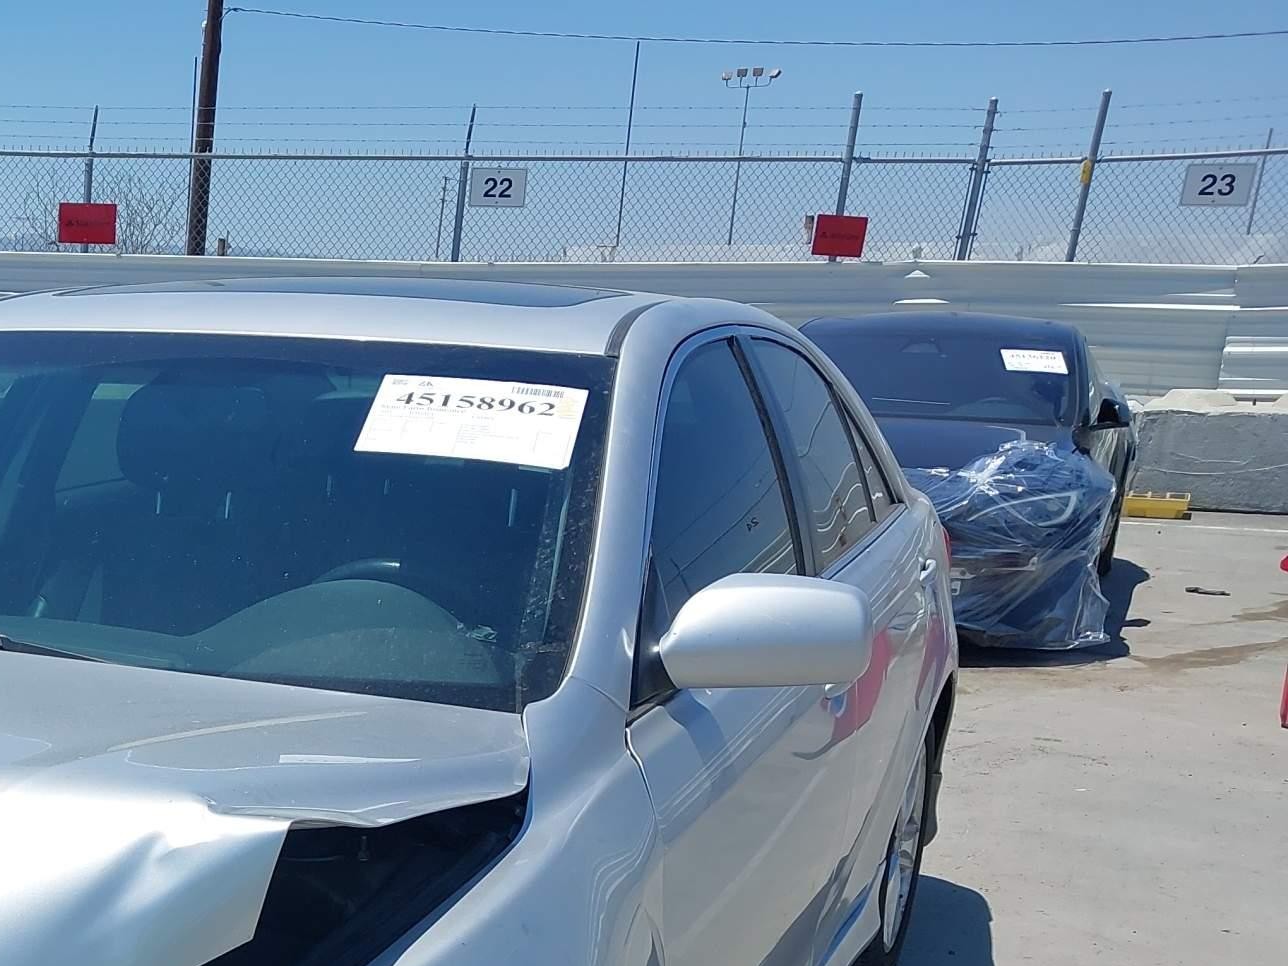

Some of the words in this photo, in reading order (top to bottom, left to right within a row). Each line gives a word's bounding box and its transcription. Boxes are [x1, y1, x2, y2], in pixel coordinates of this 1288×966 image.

[482, 177, 513, 199] 22
[1197, 173, 1236, 197] 23
[396, 391, 556, 417] 45158962
